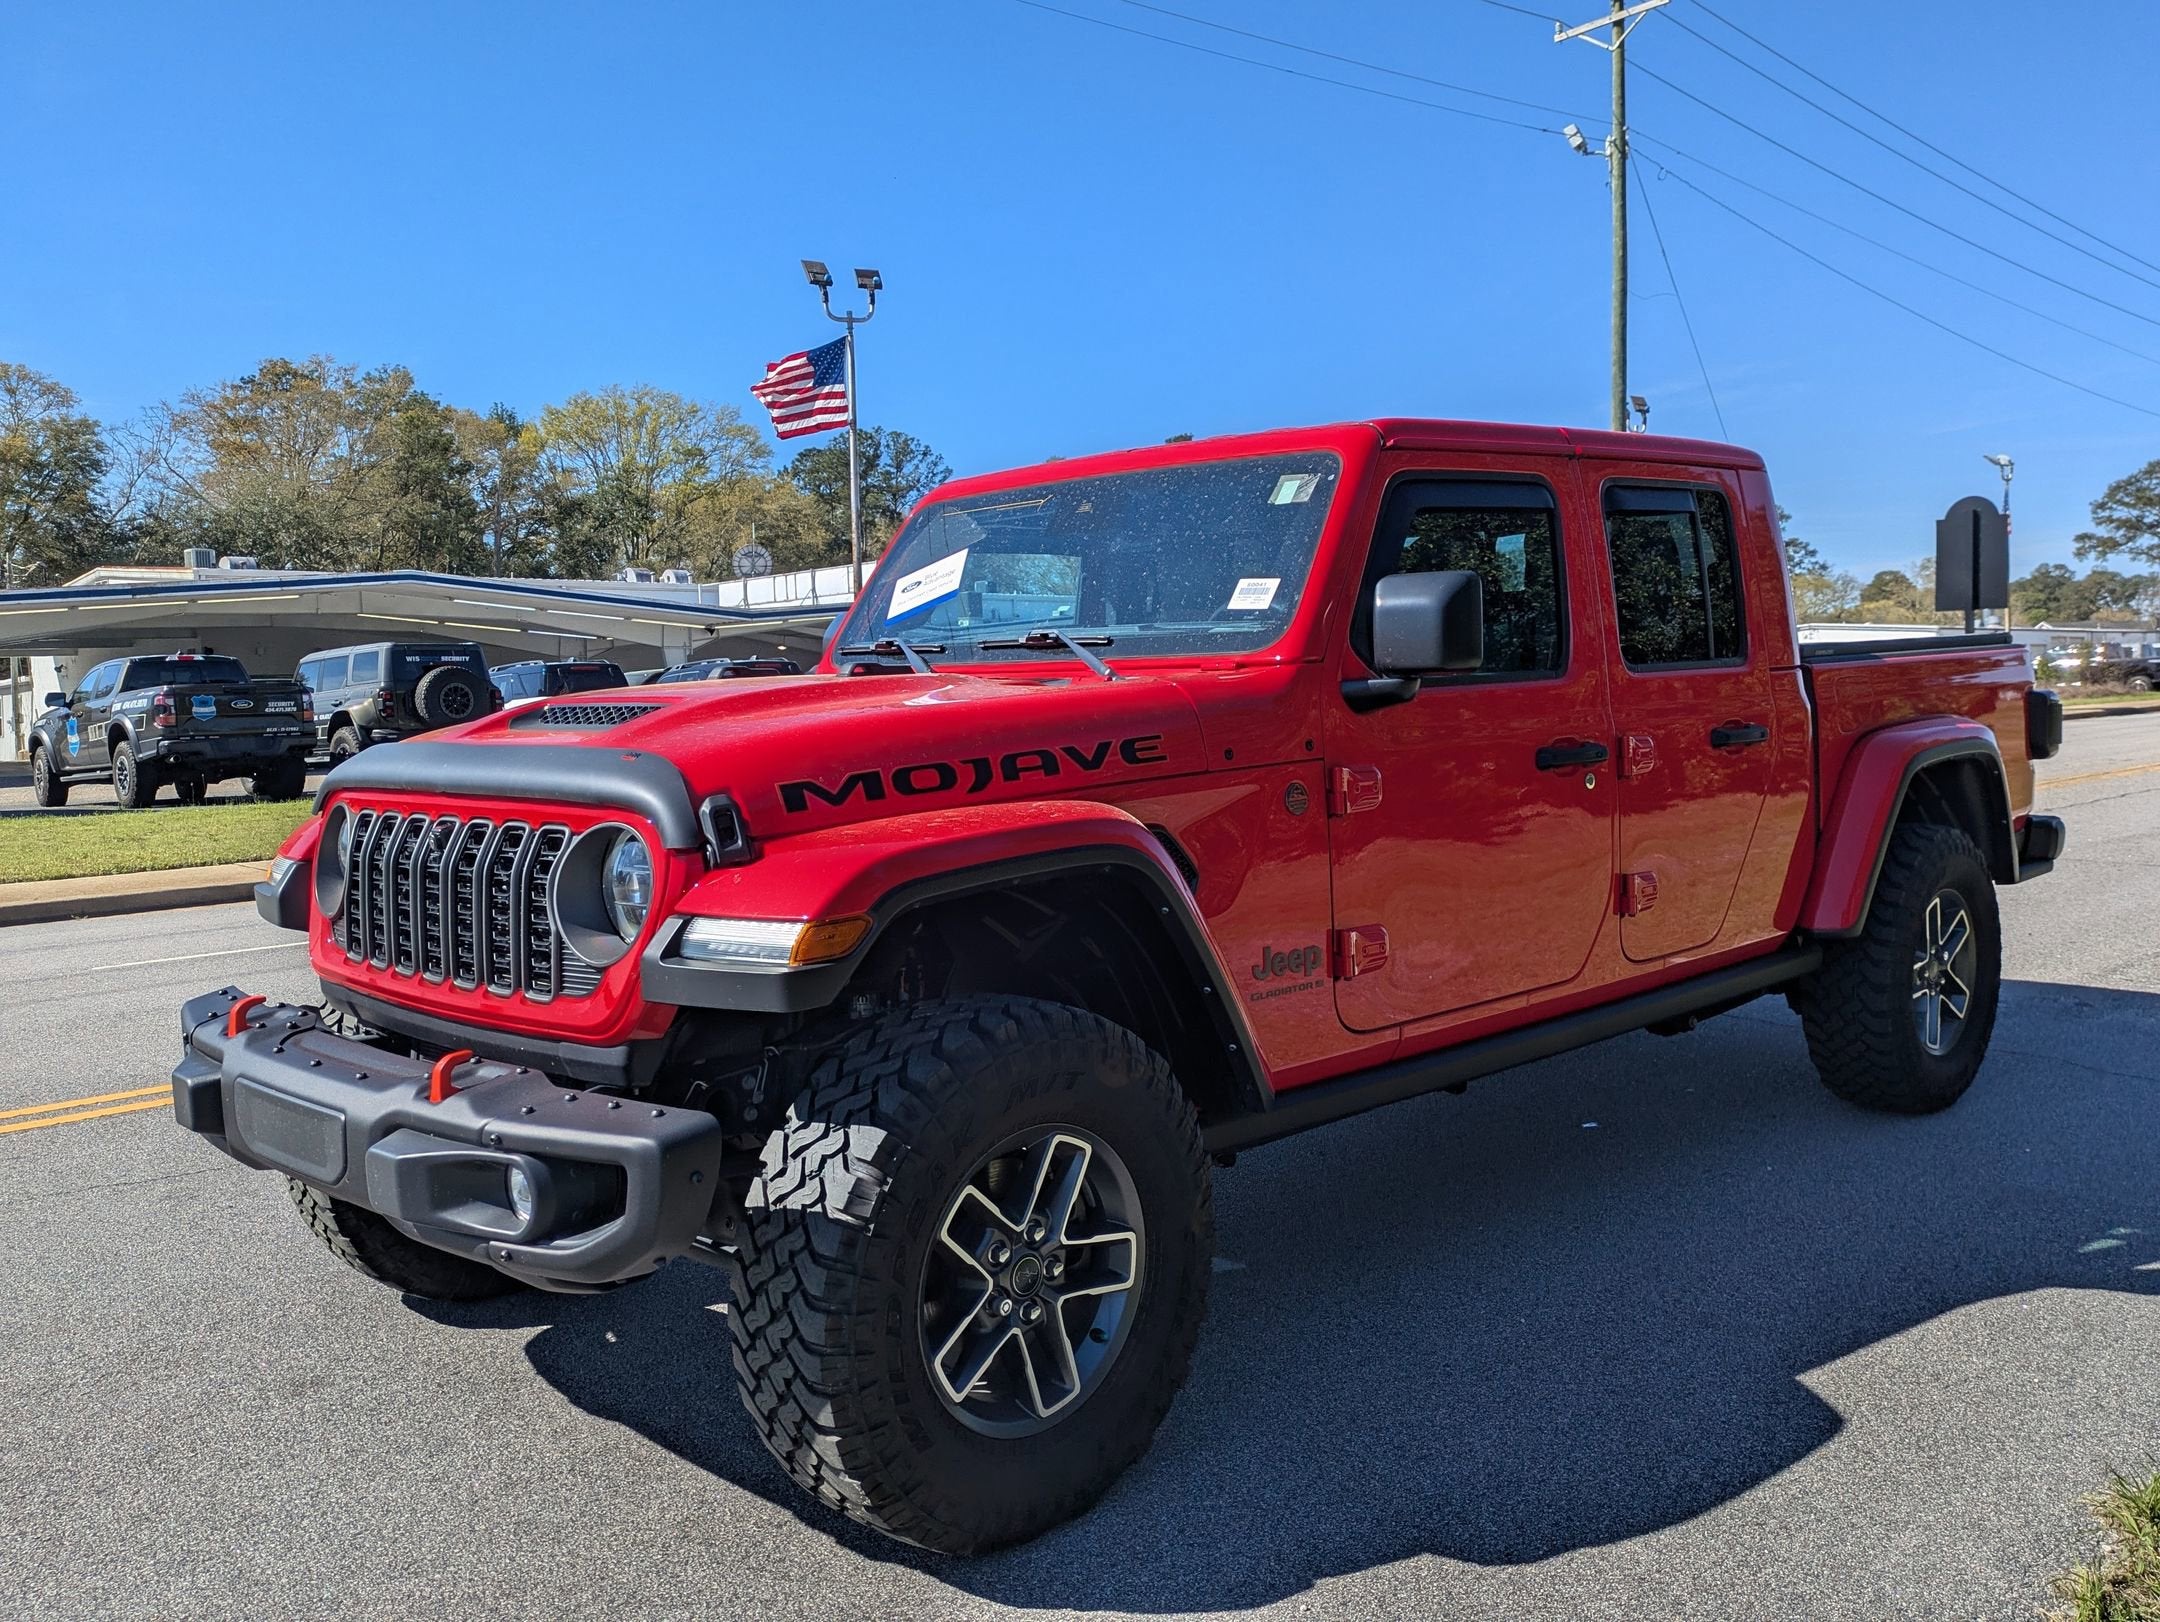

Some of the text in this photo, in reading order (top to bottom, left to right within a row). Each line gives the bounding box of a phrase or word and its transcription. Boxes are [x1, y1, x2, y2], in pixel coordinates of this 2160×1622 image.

[778, 735, 1169, 814] MOJAVE
[1251, 945, 1322, 981] Jeep
[1250, 982, 1314, 1001] GLADIATOR
